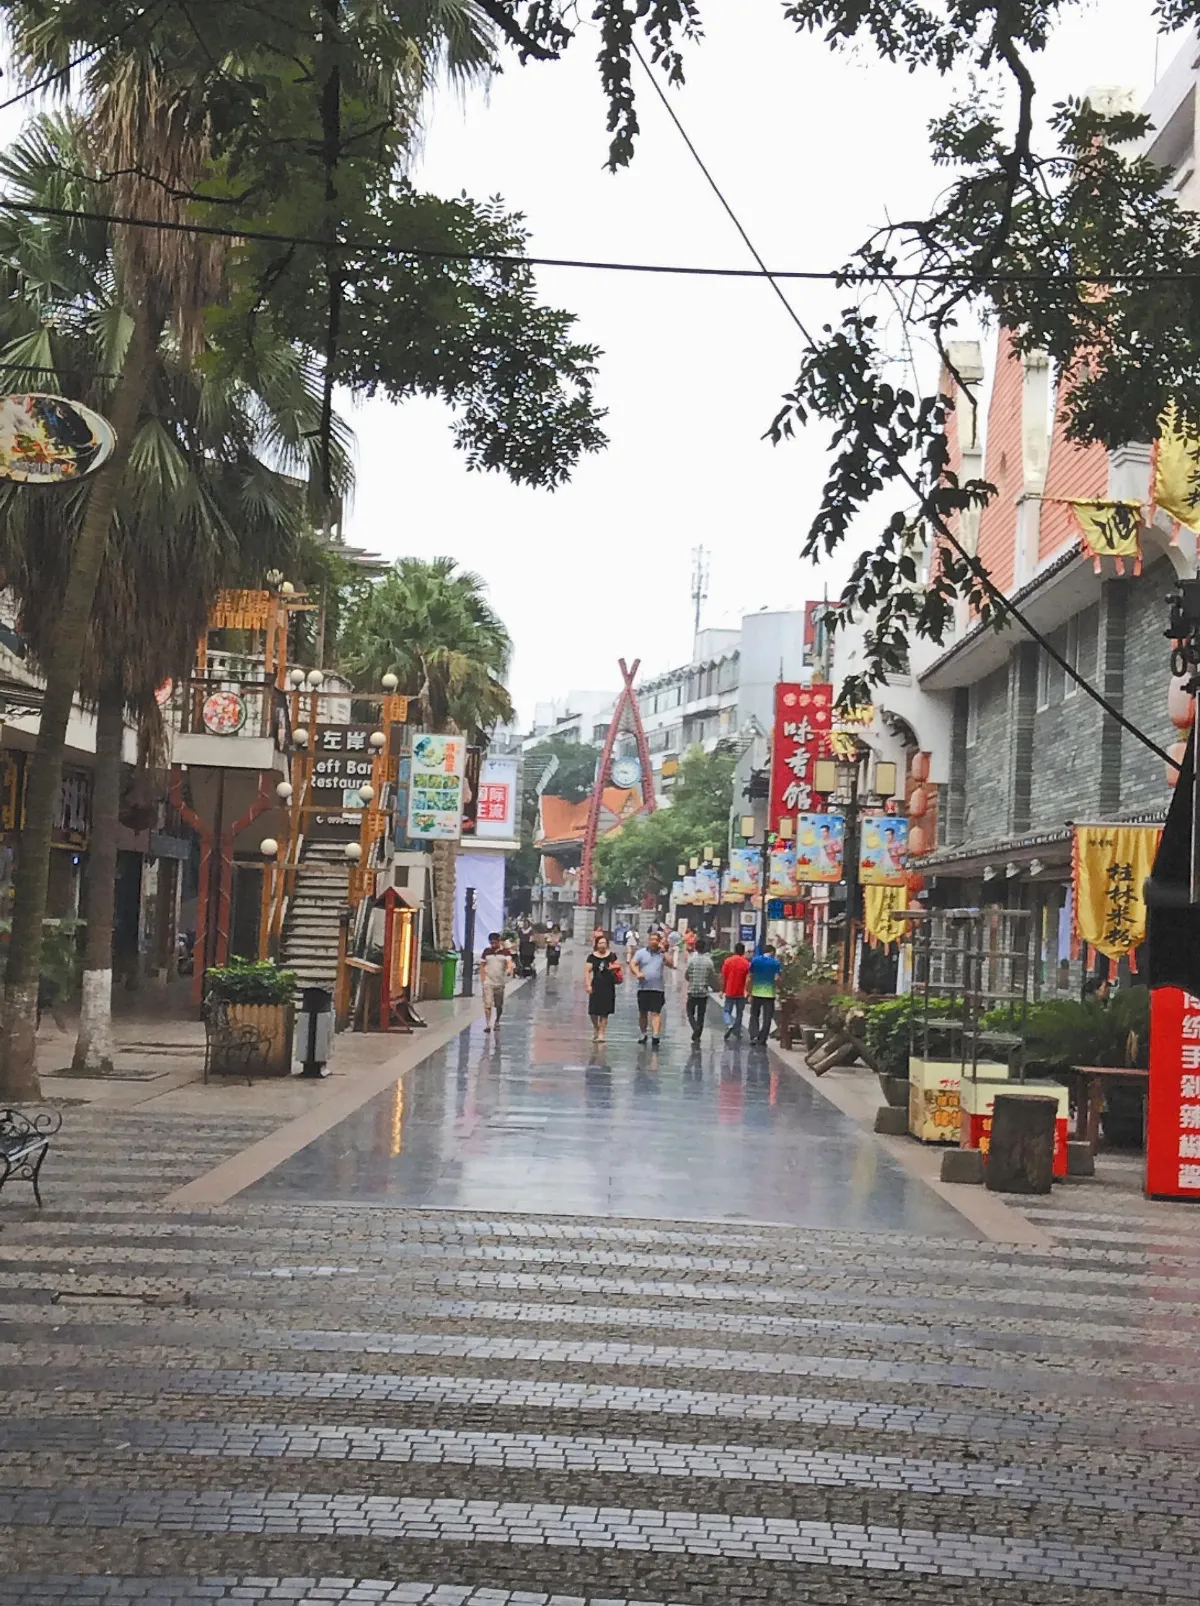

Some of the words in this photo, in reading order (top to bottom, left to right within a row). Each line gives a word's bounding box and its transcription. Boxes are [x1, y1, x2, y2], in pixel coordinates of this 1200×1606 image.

[323, 730, 367, 750] 左岸
[311, 758, 341, 773] eft
[1103, 863, 1139, 947] 桂林米粉
